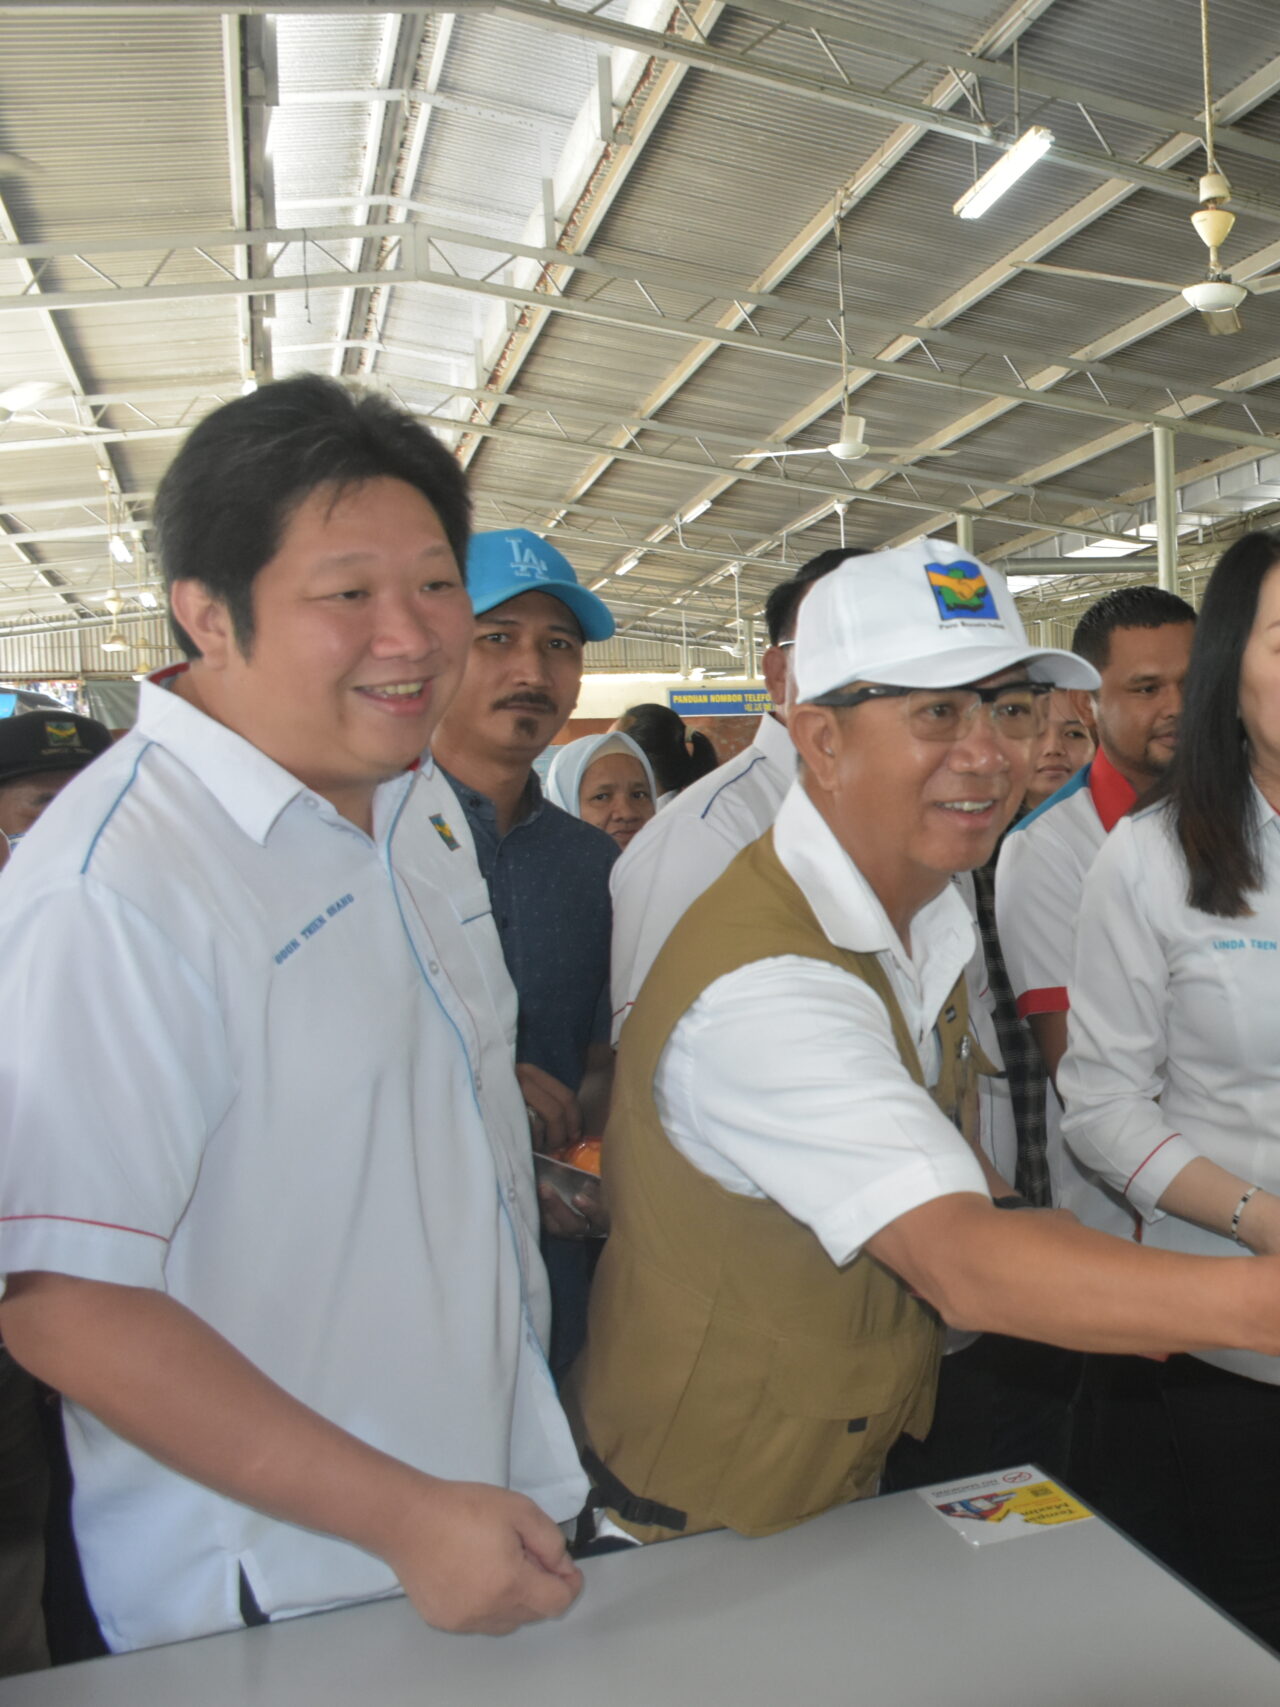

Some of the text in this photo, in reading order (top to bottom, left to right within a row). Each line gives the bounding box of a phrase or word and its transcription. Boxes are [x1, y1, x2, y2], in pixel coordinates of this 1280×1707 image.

[504, 536, 550, 580] LA
[673, 693, 772, 703] PANDUAN NOMBOR TELEFO
[1213, 938, 1246, 950] LINDA
